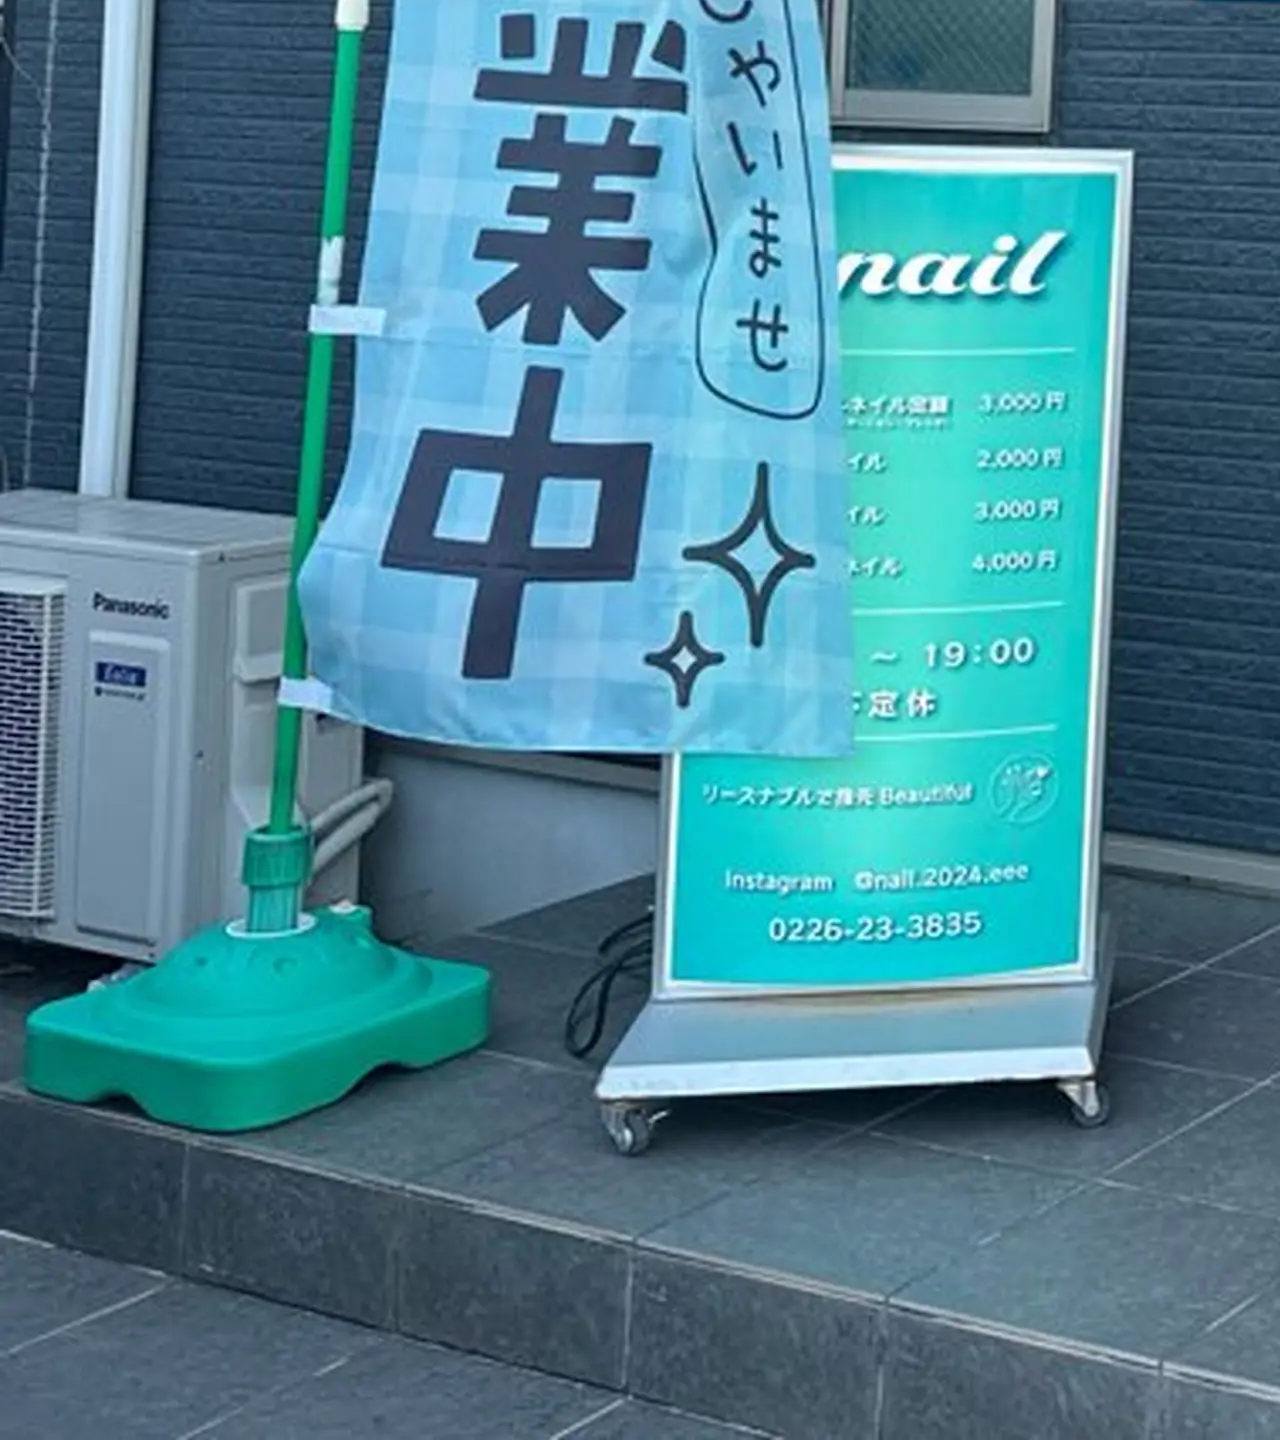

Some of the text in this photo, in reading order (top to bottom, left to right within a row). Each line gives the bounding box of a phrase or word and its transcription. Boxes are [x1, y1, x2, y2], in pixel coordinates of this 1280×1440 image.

[93, 591, 170, 620] Panasonic
[924, 636, 1035, 668] 19:00
[725, 869, 834, 895] Instagram
[768, 911, 983, 942] 0226-23-3835
